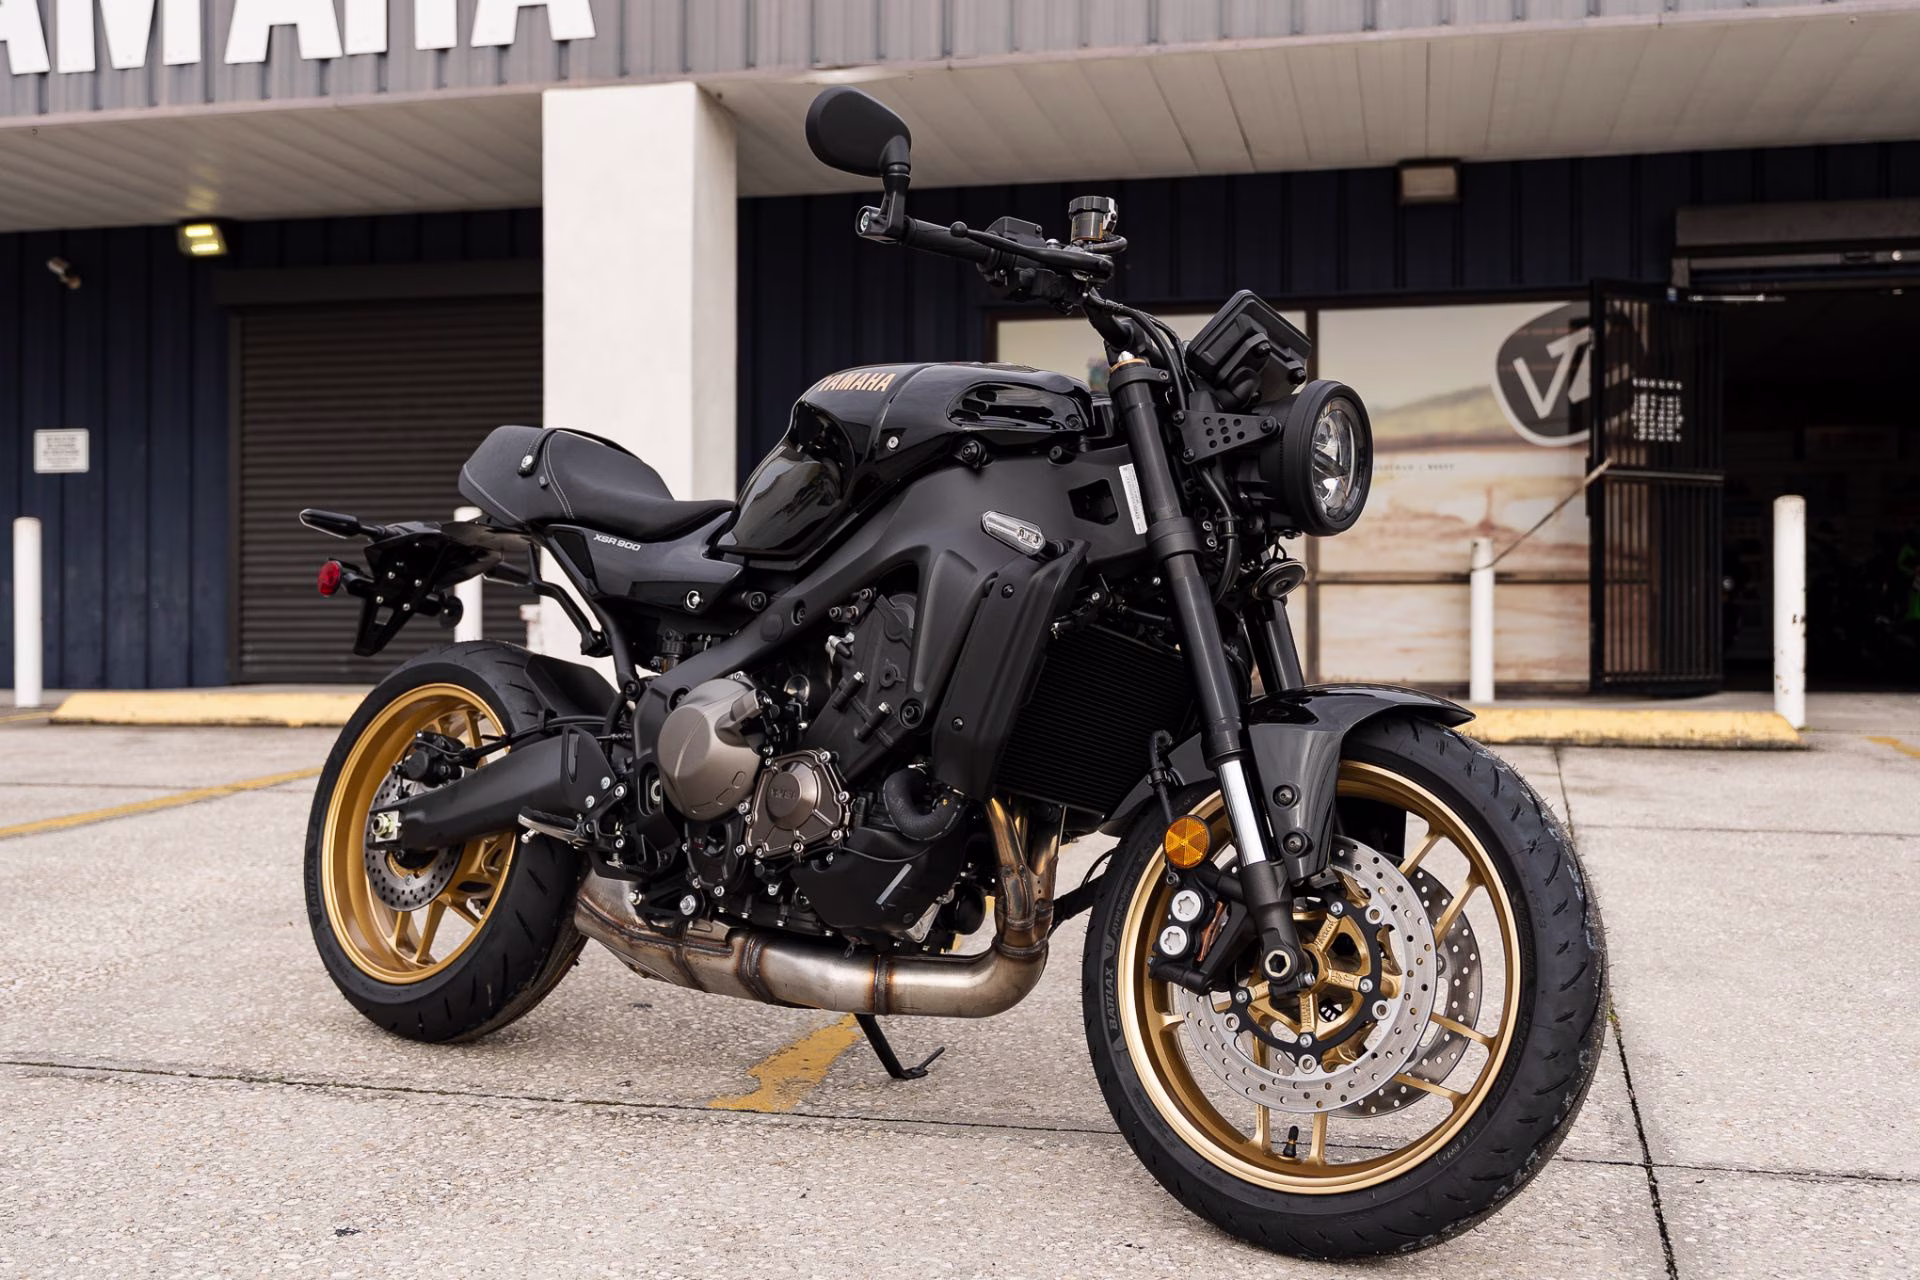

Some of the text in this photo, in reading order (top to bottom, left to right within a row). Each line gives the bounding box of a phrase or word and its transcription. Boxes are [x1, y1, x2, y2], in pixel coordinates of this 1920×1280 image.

[818, 373, 896, 392] YAMAHA
[593, 533, 642, 551] XSR 900
[1104, 967, 1118, 1031] BATTLAX
